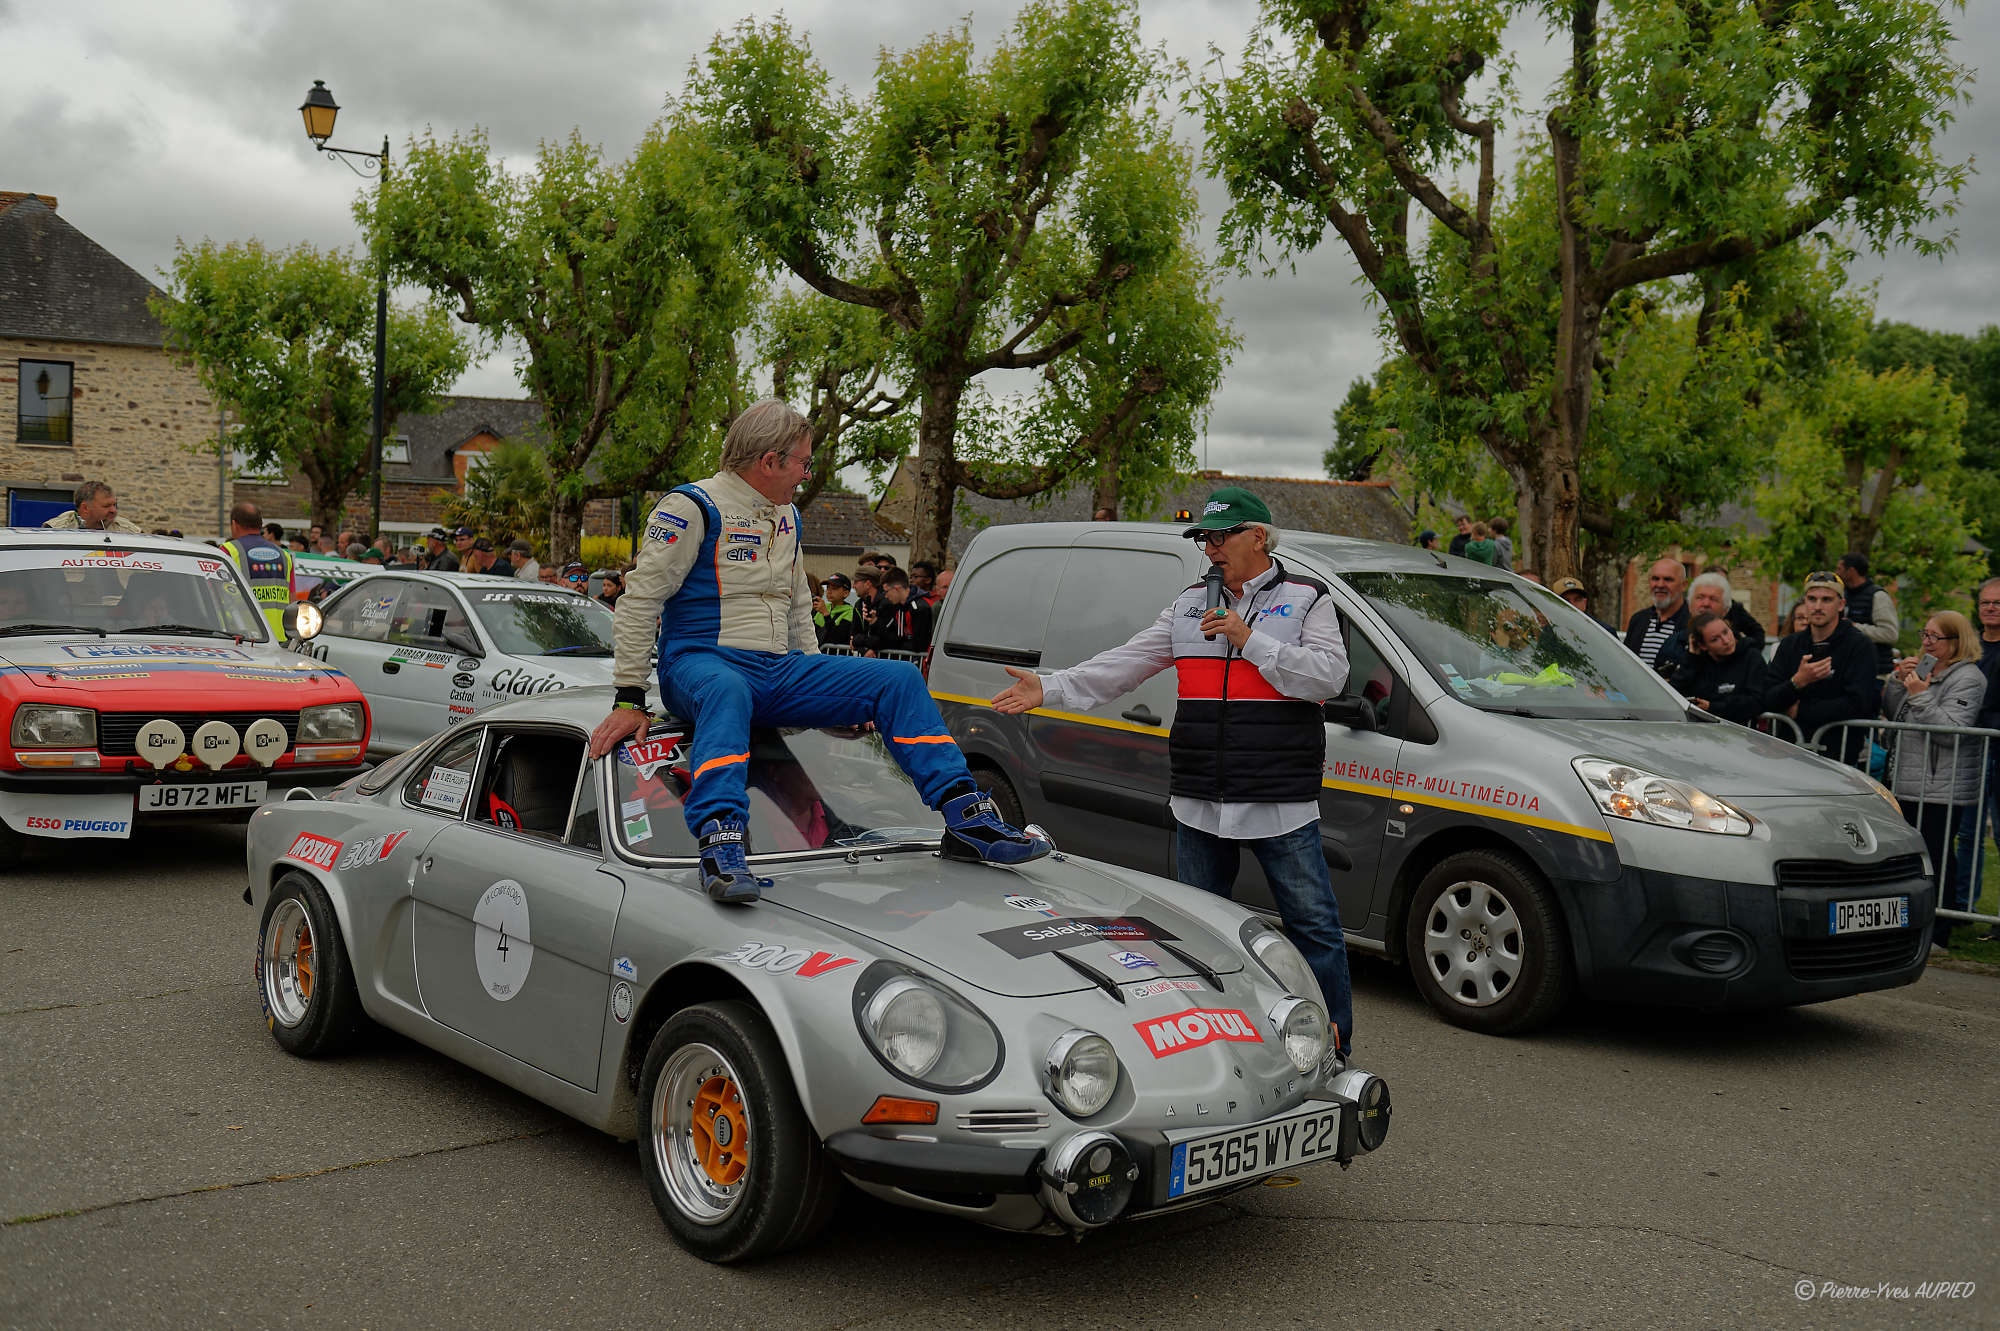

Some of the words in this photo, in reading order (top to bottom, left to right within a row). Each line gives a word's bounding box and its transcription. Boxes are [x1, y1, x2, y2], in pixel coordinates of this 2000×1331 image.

[650, 526, 667, 540] elf
[727, 548, 748, 561] elf
[61, 559, 163, 570] AUTOGLASS
[87, 650, 232, 659] PEUGEOT
[424, 651, 453, 665] MORRIS
[450, 689, 475, 703] Castrol
[150, 786, 209, 807] J872
[215, 785, 257, 805] MFL
[26, 816, 62, 830] ESSO
[63, 819, 128, 833] PEUGEOT
[289, 836, 338, 868] MOTUL
[339, 829, 412, 870] 300V
[1009, 898, 1046, 909] VHC
[497, 921, 509, 963] 4
[717, 943, 861, 980] 300V
[1148, 1012, 1256, 1052] MOTUL
[1166, 1080, 1295, 1116] ALPINE
[1188, 1131, 1259, 1186] 5365
[1265, 1122, 1298, 1167] WY
[1301, 1114, 1334, 1157] 22
[1173, 1175, 1180, 1189] F
